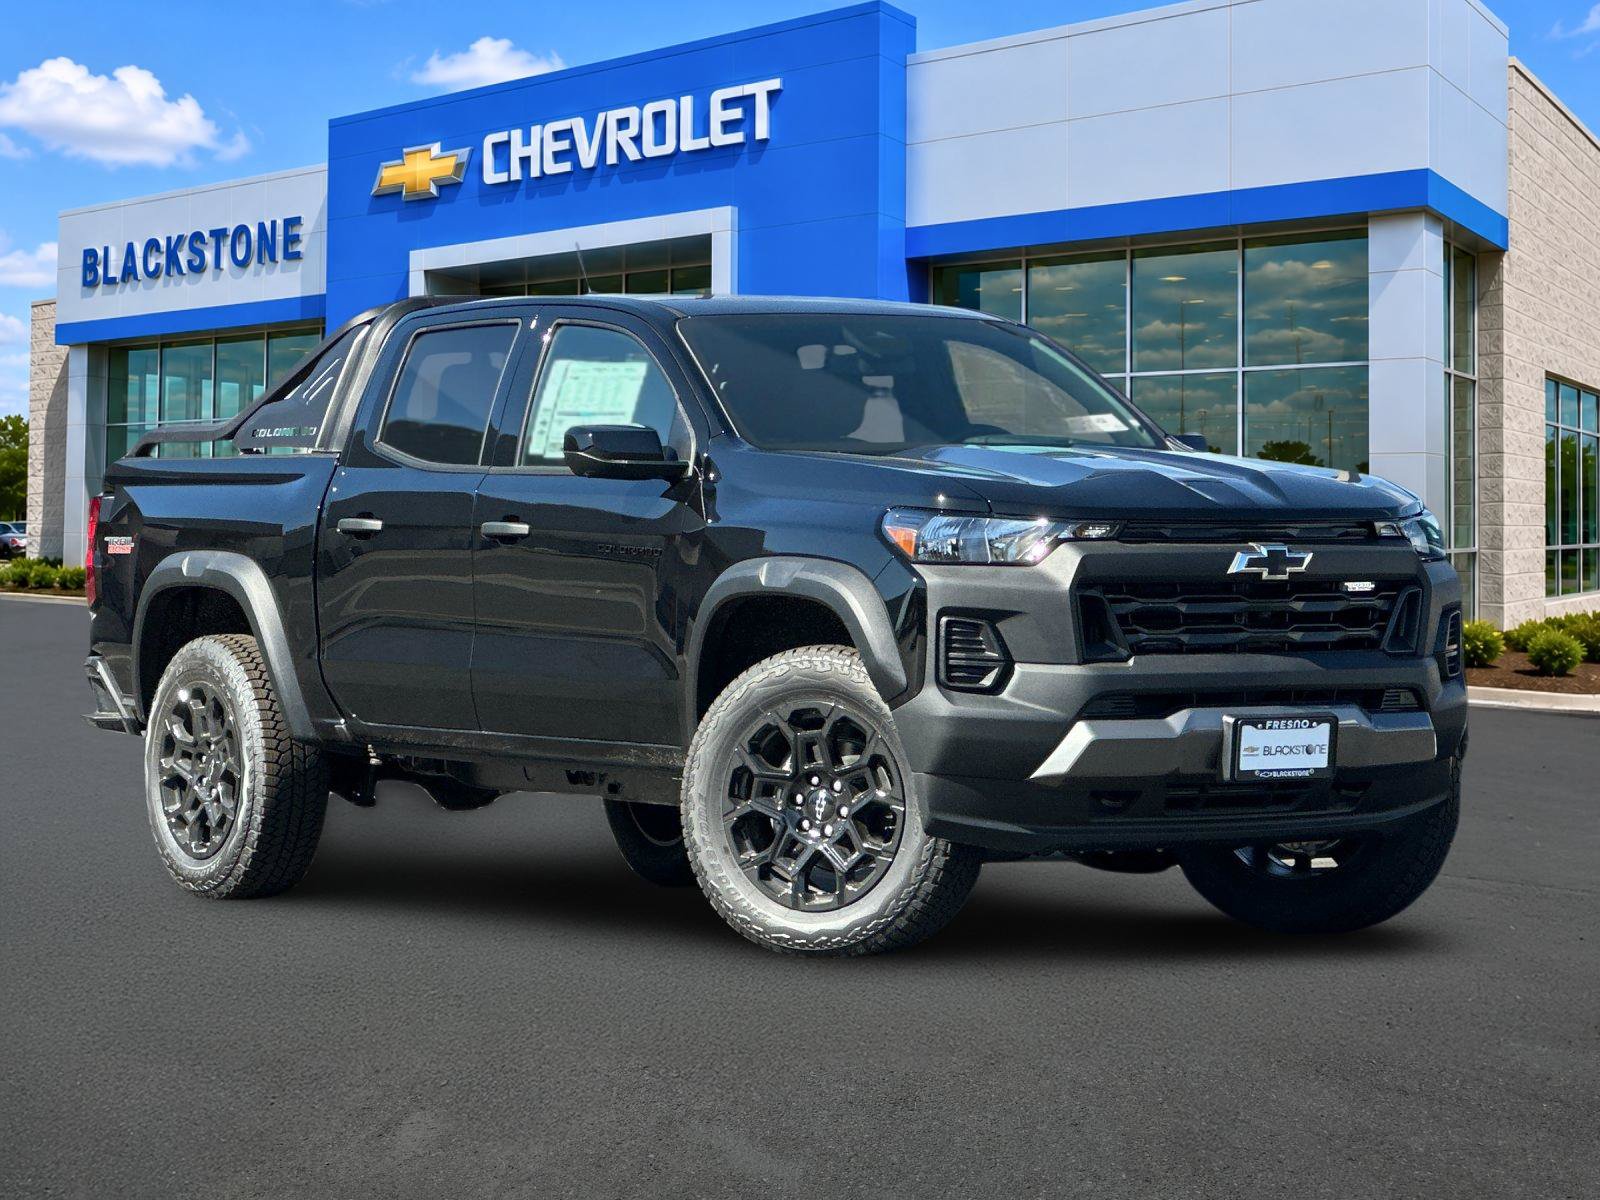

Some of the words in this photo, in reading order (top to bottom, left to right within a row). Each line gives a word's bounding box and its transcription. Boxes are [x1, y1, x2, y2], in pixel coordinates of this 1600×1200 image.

[482, 77, 783, 186] CHEVROLET
[82, 216, 304, 288] BLACKSTONE
[1265, 719, 1310, 730] FRESNO
[1262, 743, 1328, 756] BLACKSTONE
[1272, 769, 1311, 778] BLACKSTONE
